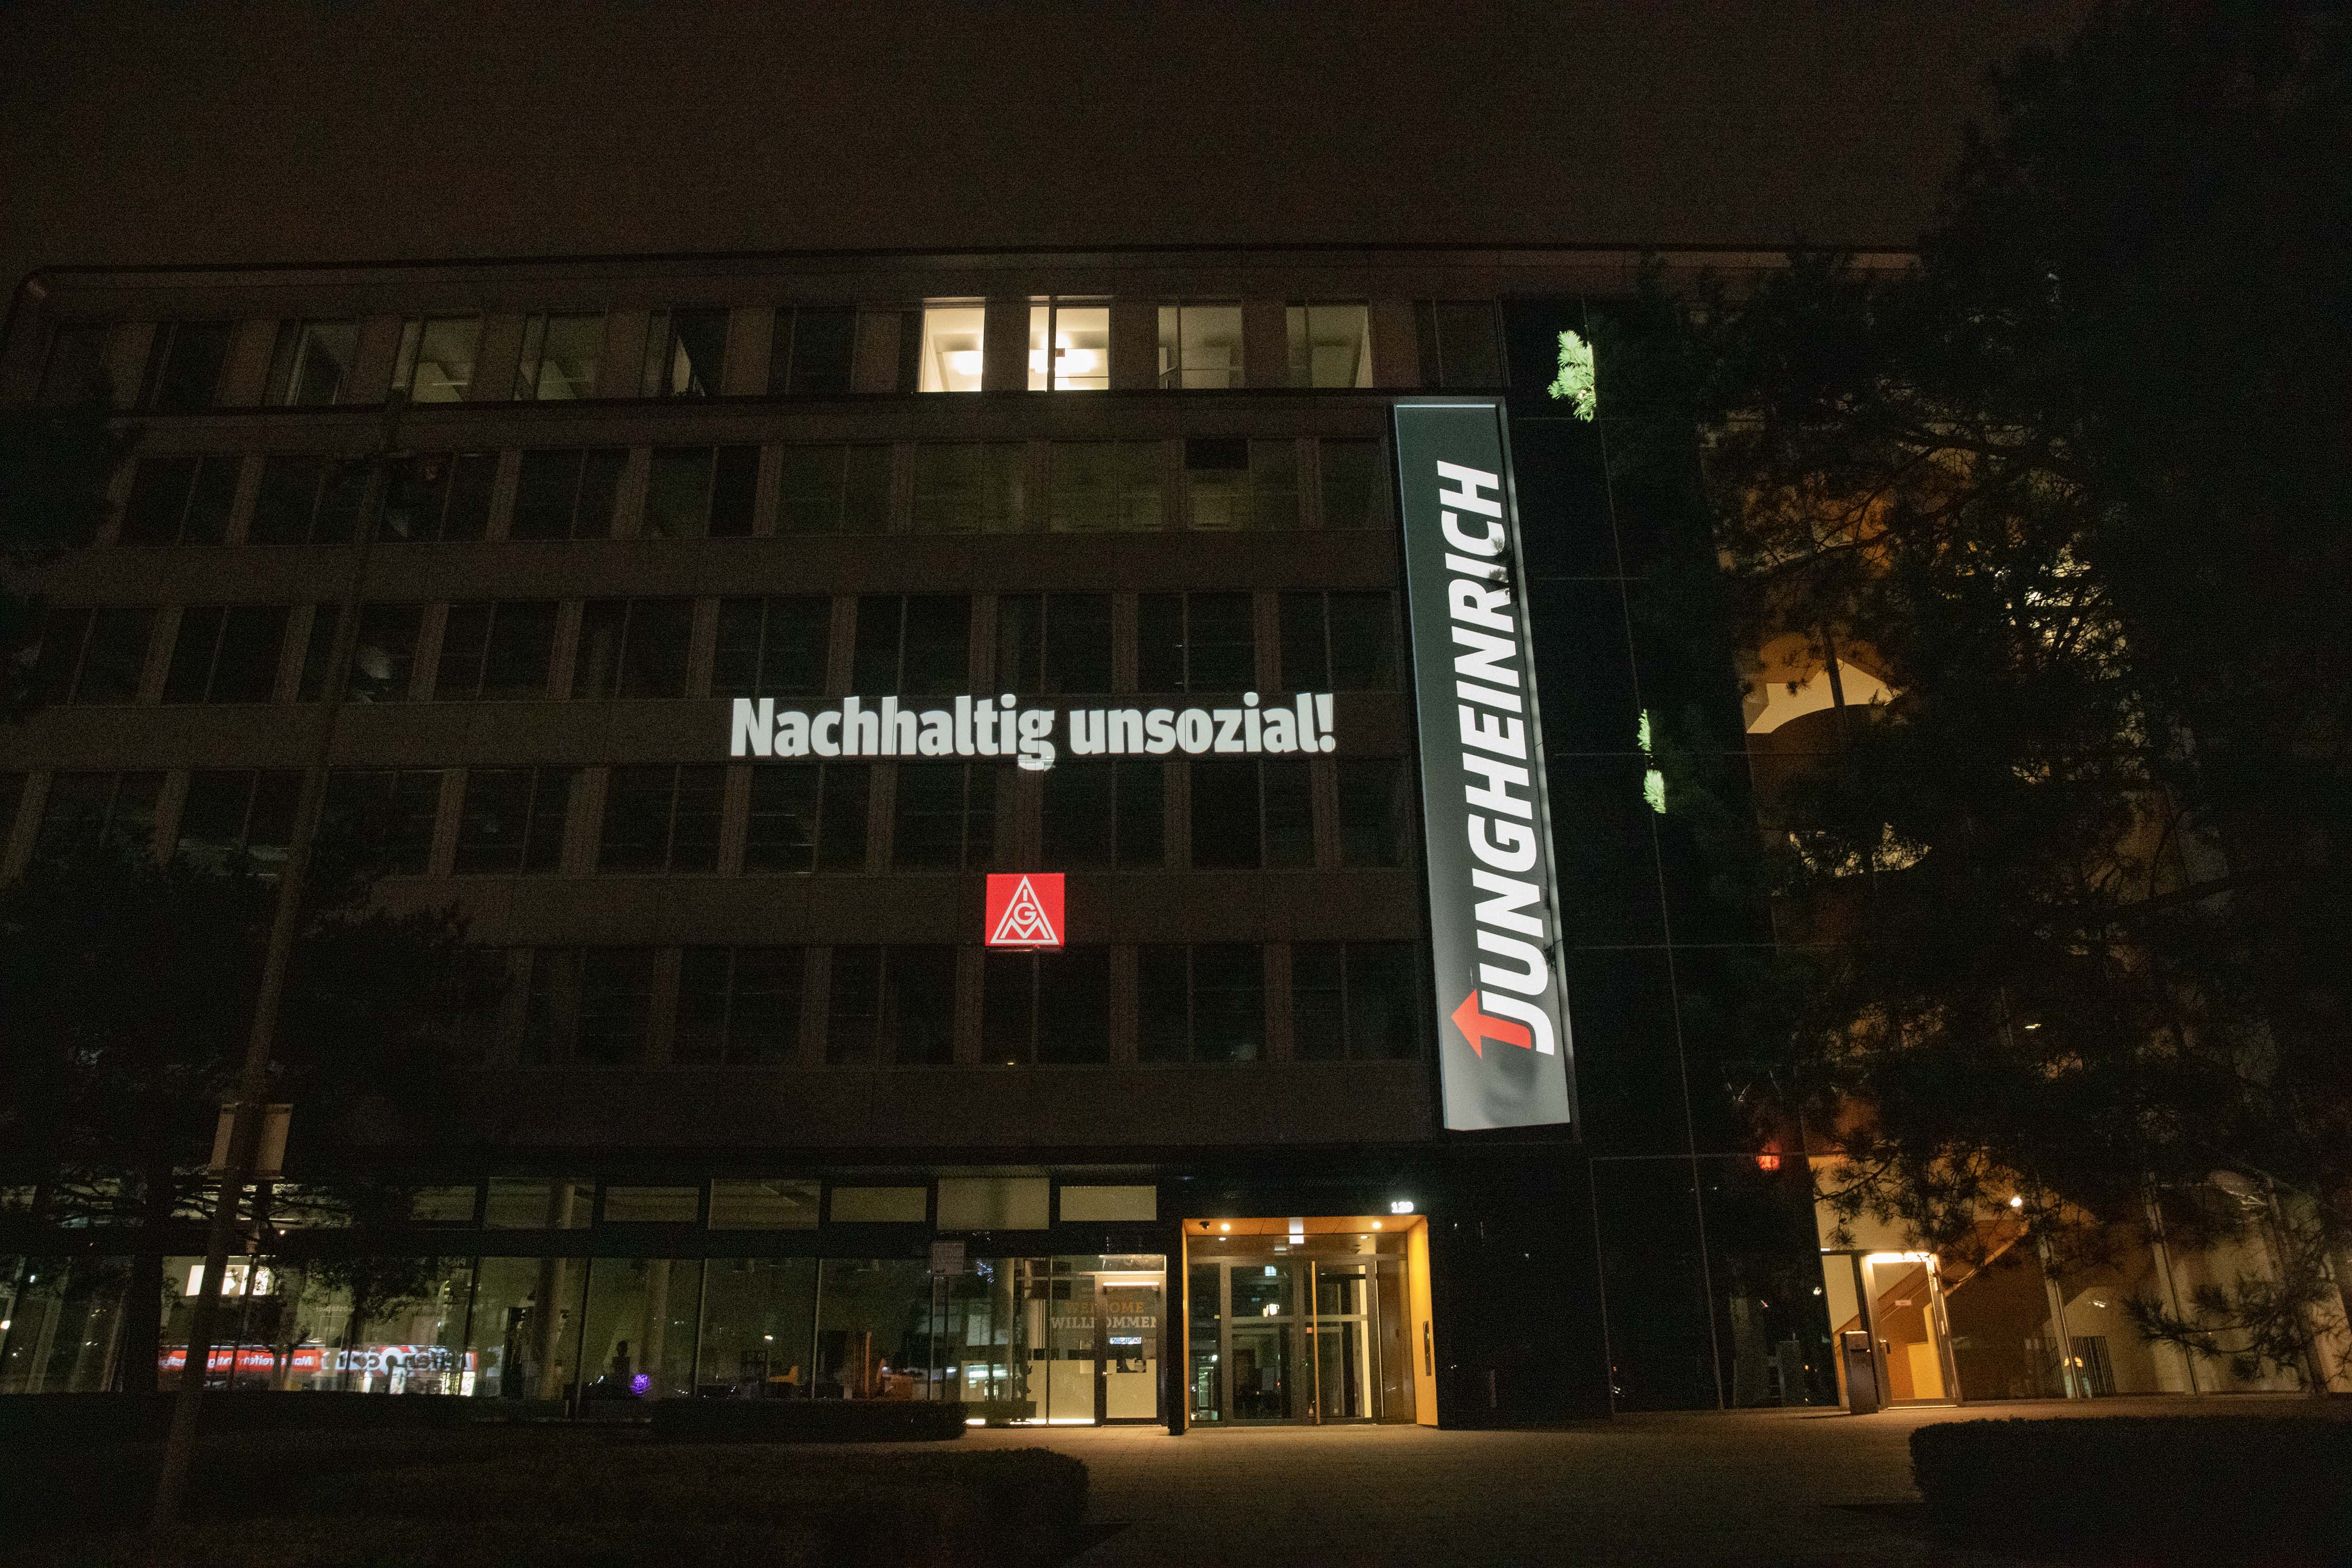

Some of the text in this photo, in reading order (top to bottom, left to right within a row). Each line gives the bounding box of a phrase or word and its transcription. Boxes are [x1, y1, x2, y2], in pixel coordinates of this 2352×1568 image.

[731, 692, 1335, 771] Nachhaltig unsozial!
[1437, 460, 1554, 1055] JUNGHEINRICH
[1051, 1317, 1157, 1329] WILLMME
